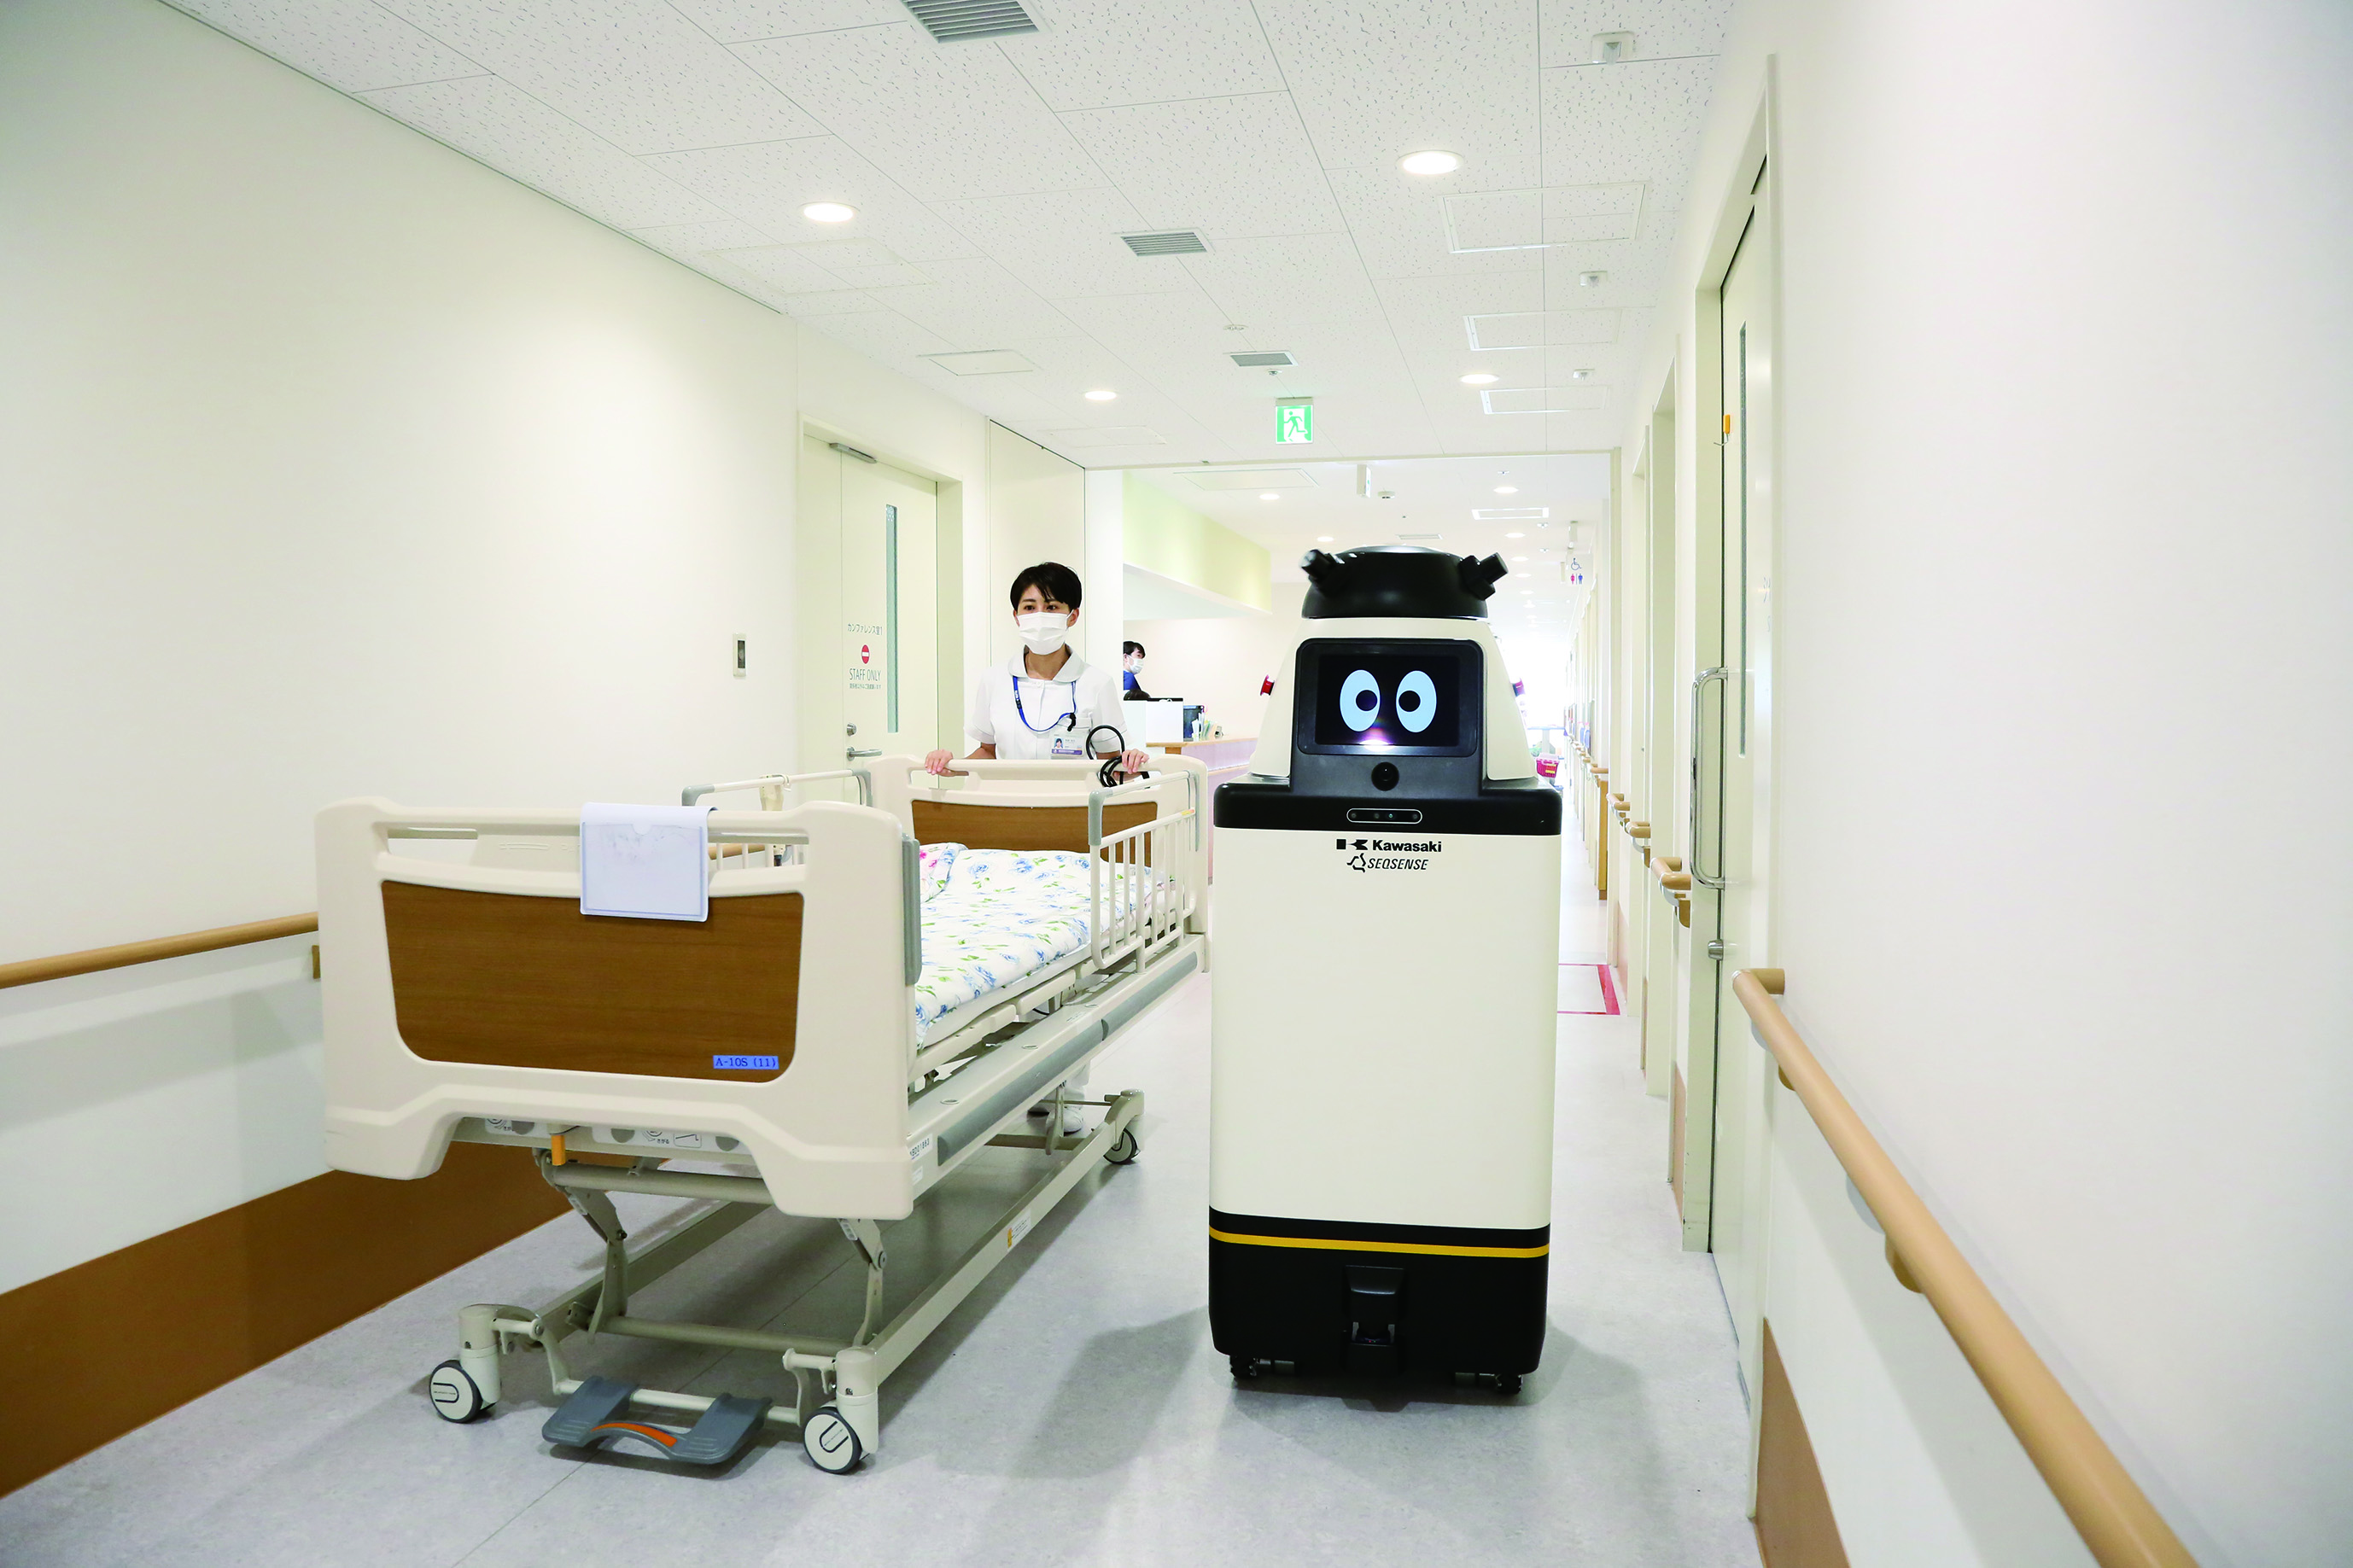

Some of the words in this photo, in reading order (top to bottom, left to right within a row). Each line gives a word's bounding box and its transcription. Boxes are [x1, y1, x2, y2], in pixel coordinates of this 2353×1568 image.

[849, 668, 866, 680] STAFF
[867, 669, 881, 681] ONLY
[1372, 840, 1442, 852] Kawasaki
[1367, 858, 1428, 870] SEQSENSE
[715, 1058, 748, 1067] A-10S
[753, 1058, 776, 1068] (11)
